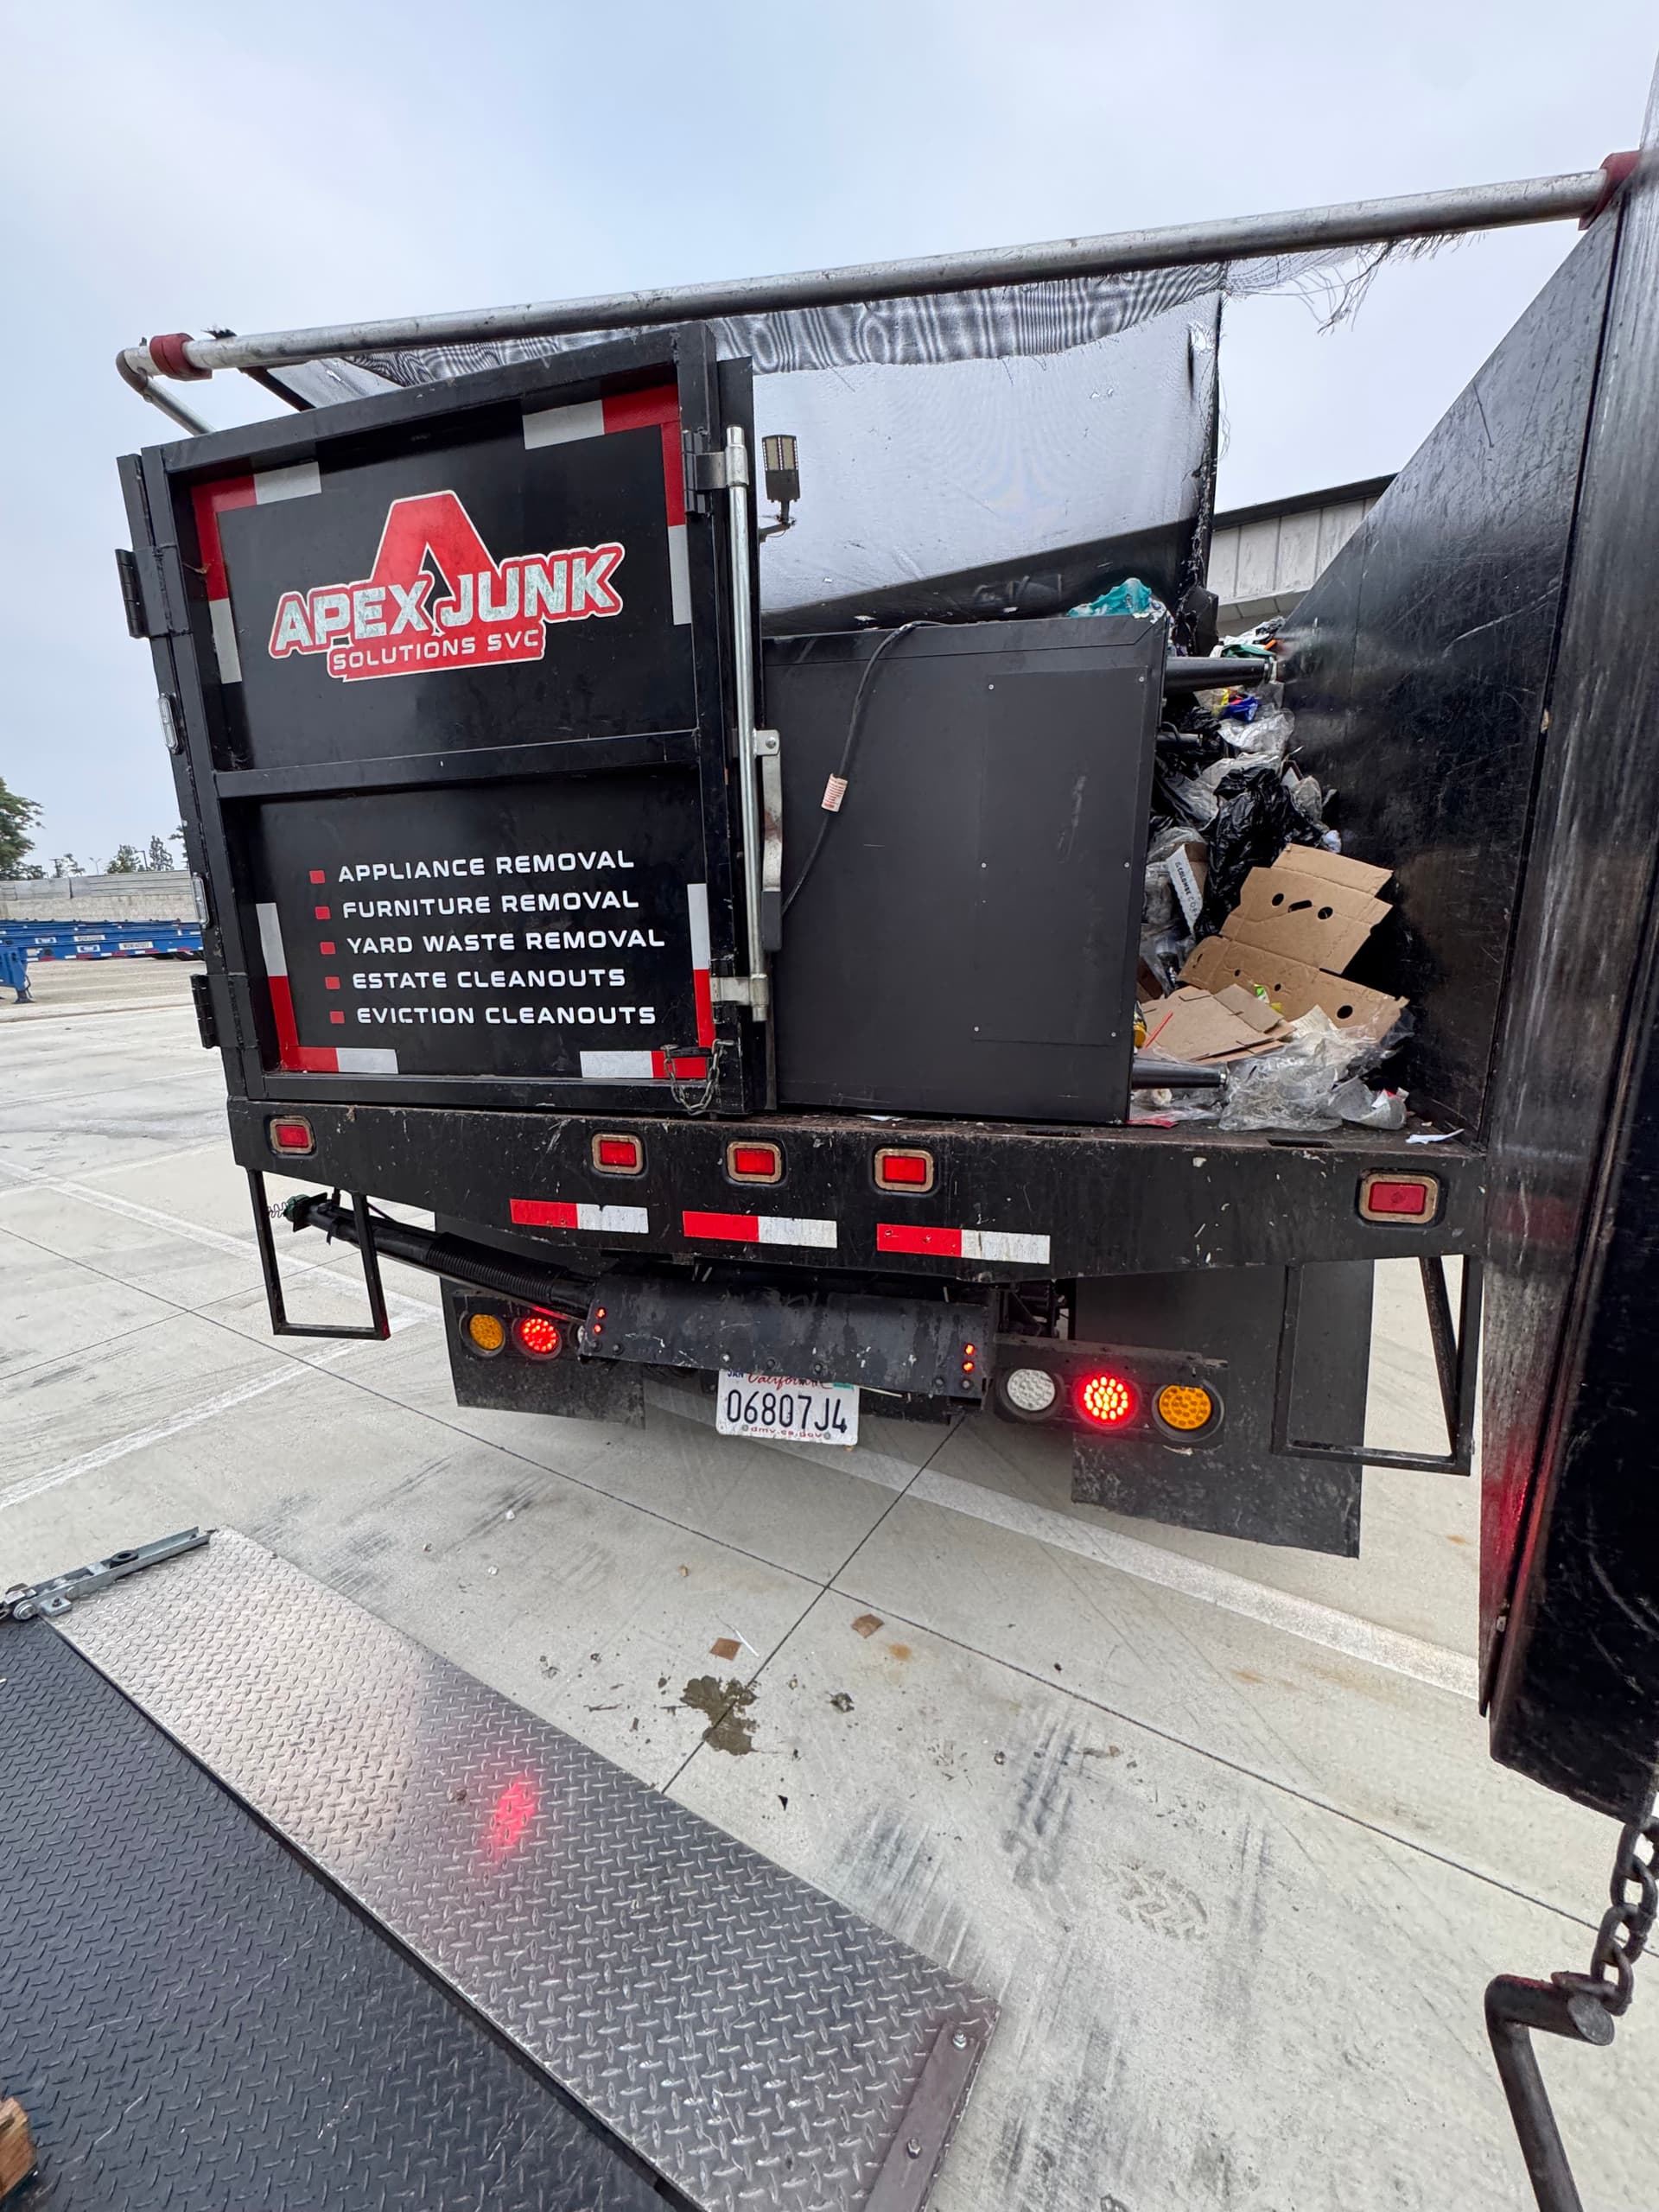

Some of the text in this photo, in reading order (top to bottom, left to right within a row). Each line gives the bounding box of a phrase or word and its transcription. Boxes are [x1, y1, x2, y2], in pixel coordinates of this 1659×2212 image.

[275, 553, 616, 651] APEX JUNK
[333, 628, 540, 671] SOLUTIONS SVC
[338, 850, 635, 883] APPLIANCE REMOVAL
[343, 890, 639, 919] FURNITURE REMOVAL
[346, 929, 665, 955] YARD WASTE REMOVAL
[353, 968, 626, 990] ESTATE CLEANOUTS
[356, 1006, 657, 1025] EVICTION CLEANOUTS
[728, 1389, 848, 1433] 06807J4
